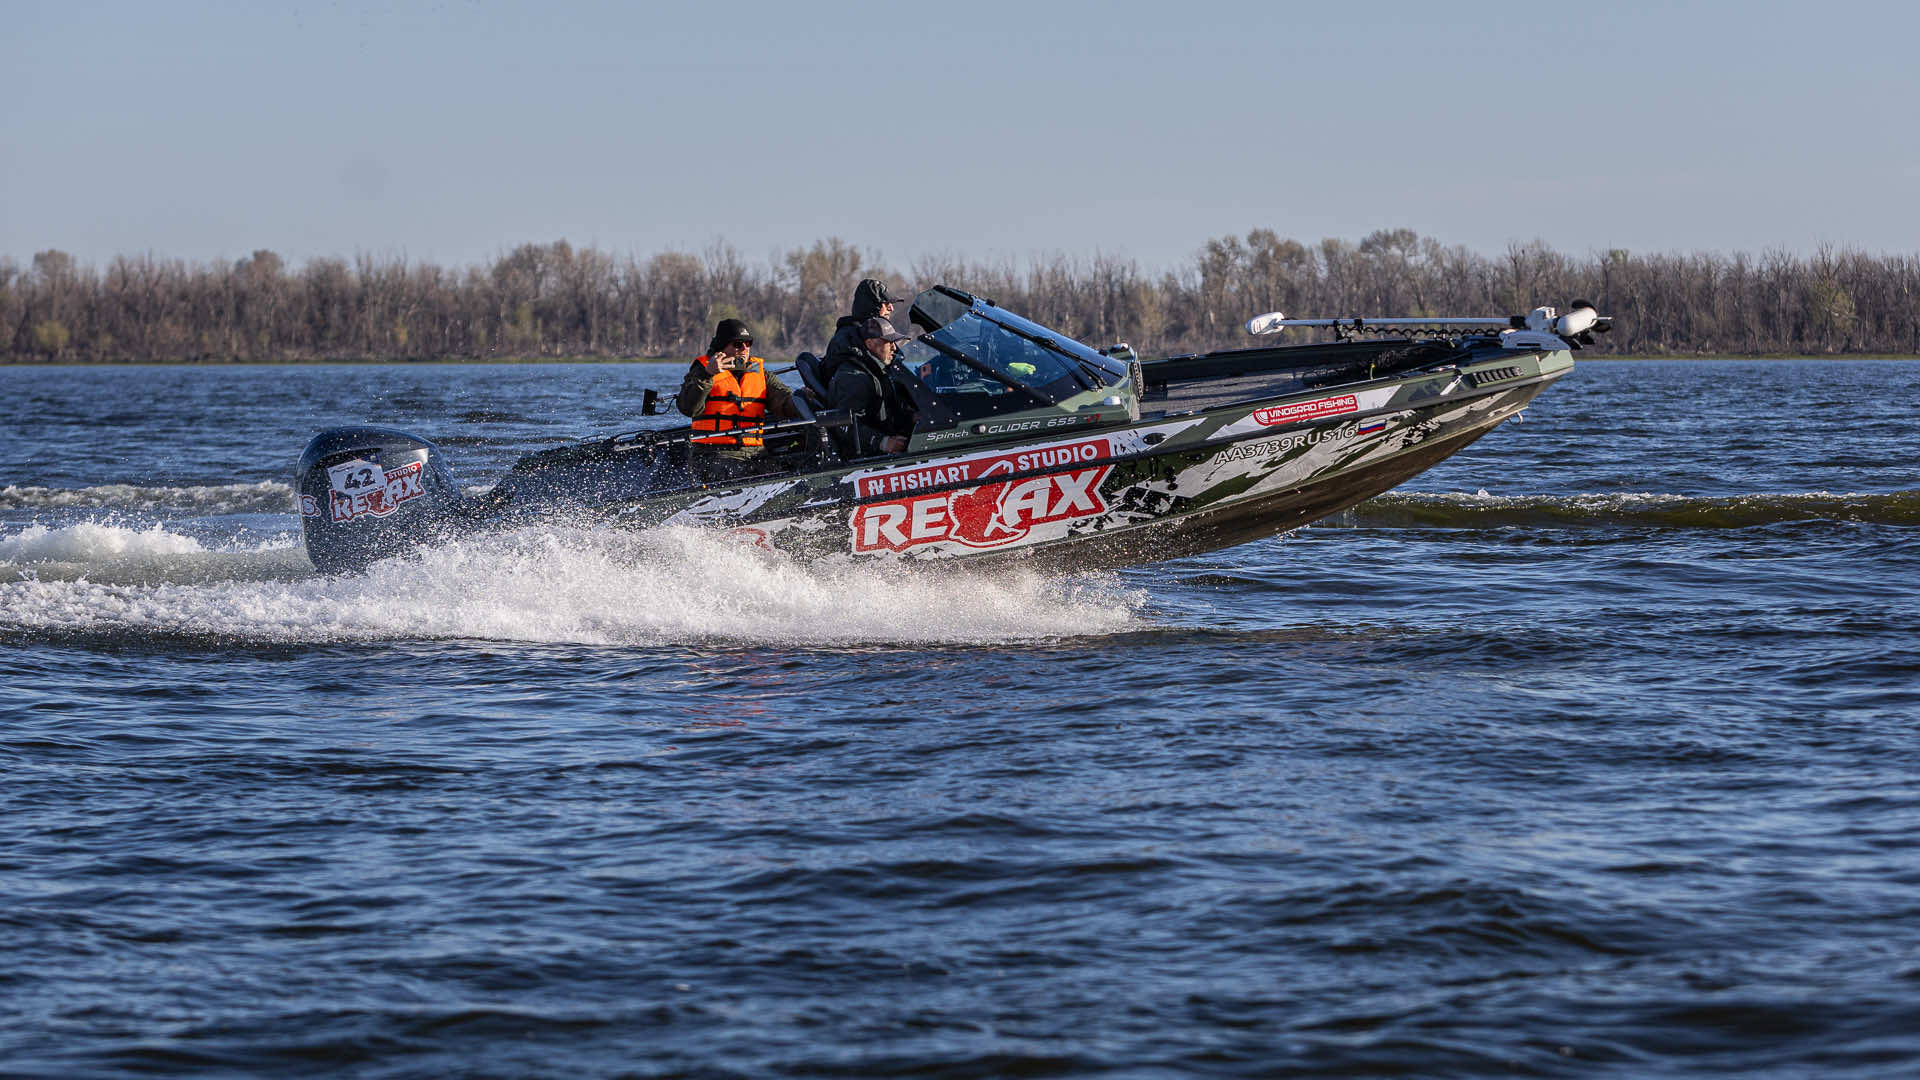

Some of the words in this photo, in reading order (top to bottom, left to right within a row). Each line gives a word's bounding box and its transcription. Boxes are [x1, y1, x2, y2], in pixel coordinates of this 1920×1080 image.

[1317, 397, 1355, 410] FISHING
[926, 430, 969, 442] Spinch
[987, 421, 1041, 434] GLIDER
[1047, 416, 1077, 427] 655
[1215, 424, 1357, 464] AA3739RUS16
[344, 468, 376, 490] 42
[388, 464, 418, 479] STUDIO
[890, 465, 970, 491] FISHART
[1017, 444, 1098, 471] STUDIO
